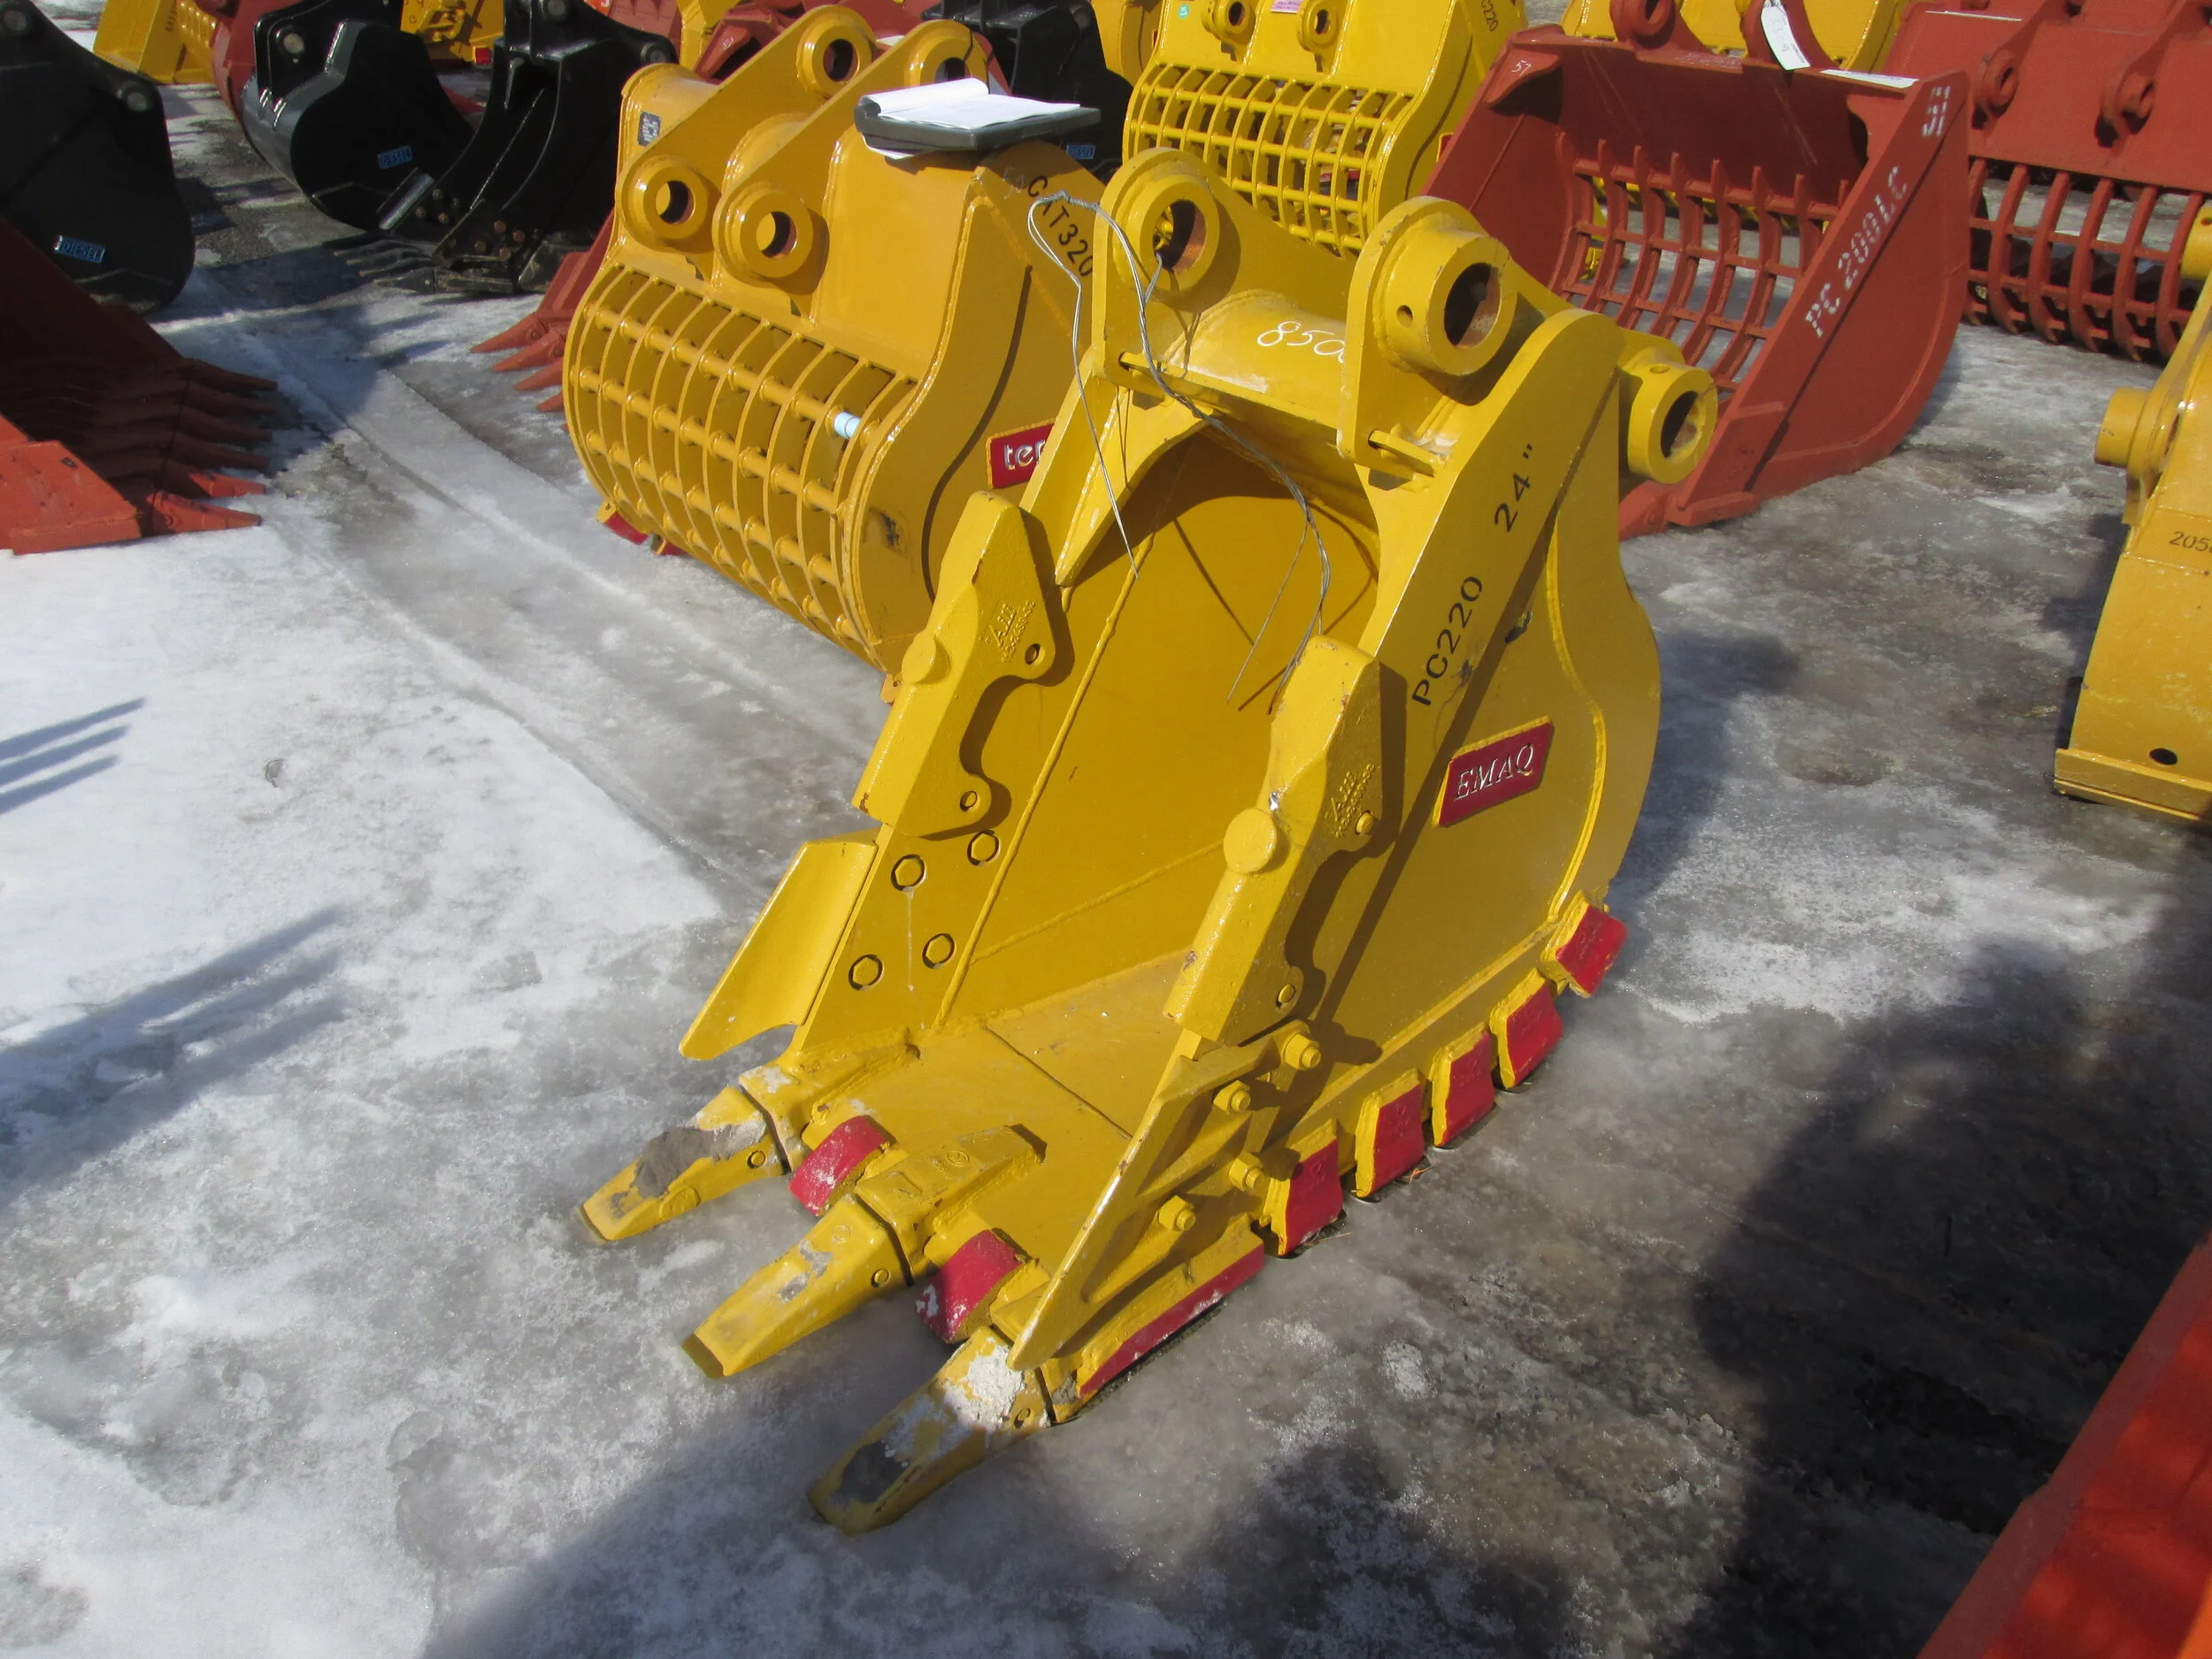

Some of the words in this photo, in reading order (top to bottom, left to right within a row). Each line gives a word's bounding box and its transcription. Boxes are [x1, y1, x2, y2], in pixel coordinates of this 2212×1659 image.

[1805, 282, 1841, 337] PC
[1256, 320, 1345, 364] 850
[2169, 531, 2212, 554] 205
[1411, 575, 1484, 706] PC220
[1452, 742, 1535, 802] EMAQ
